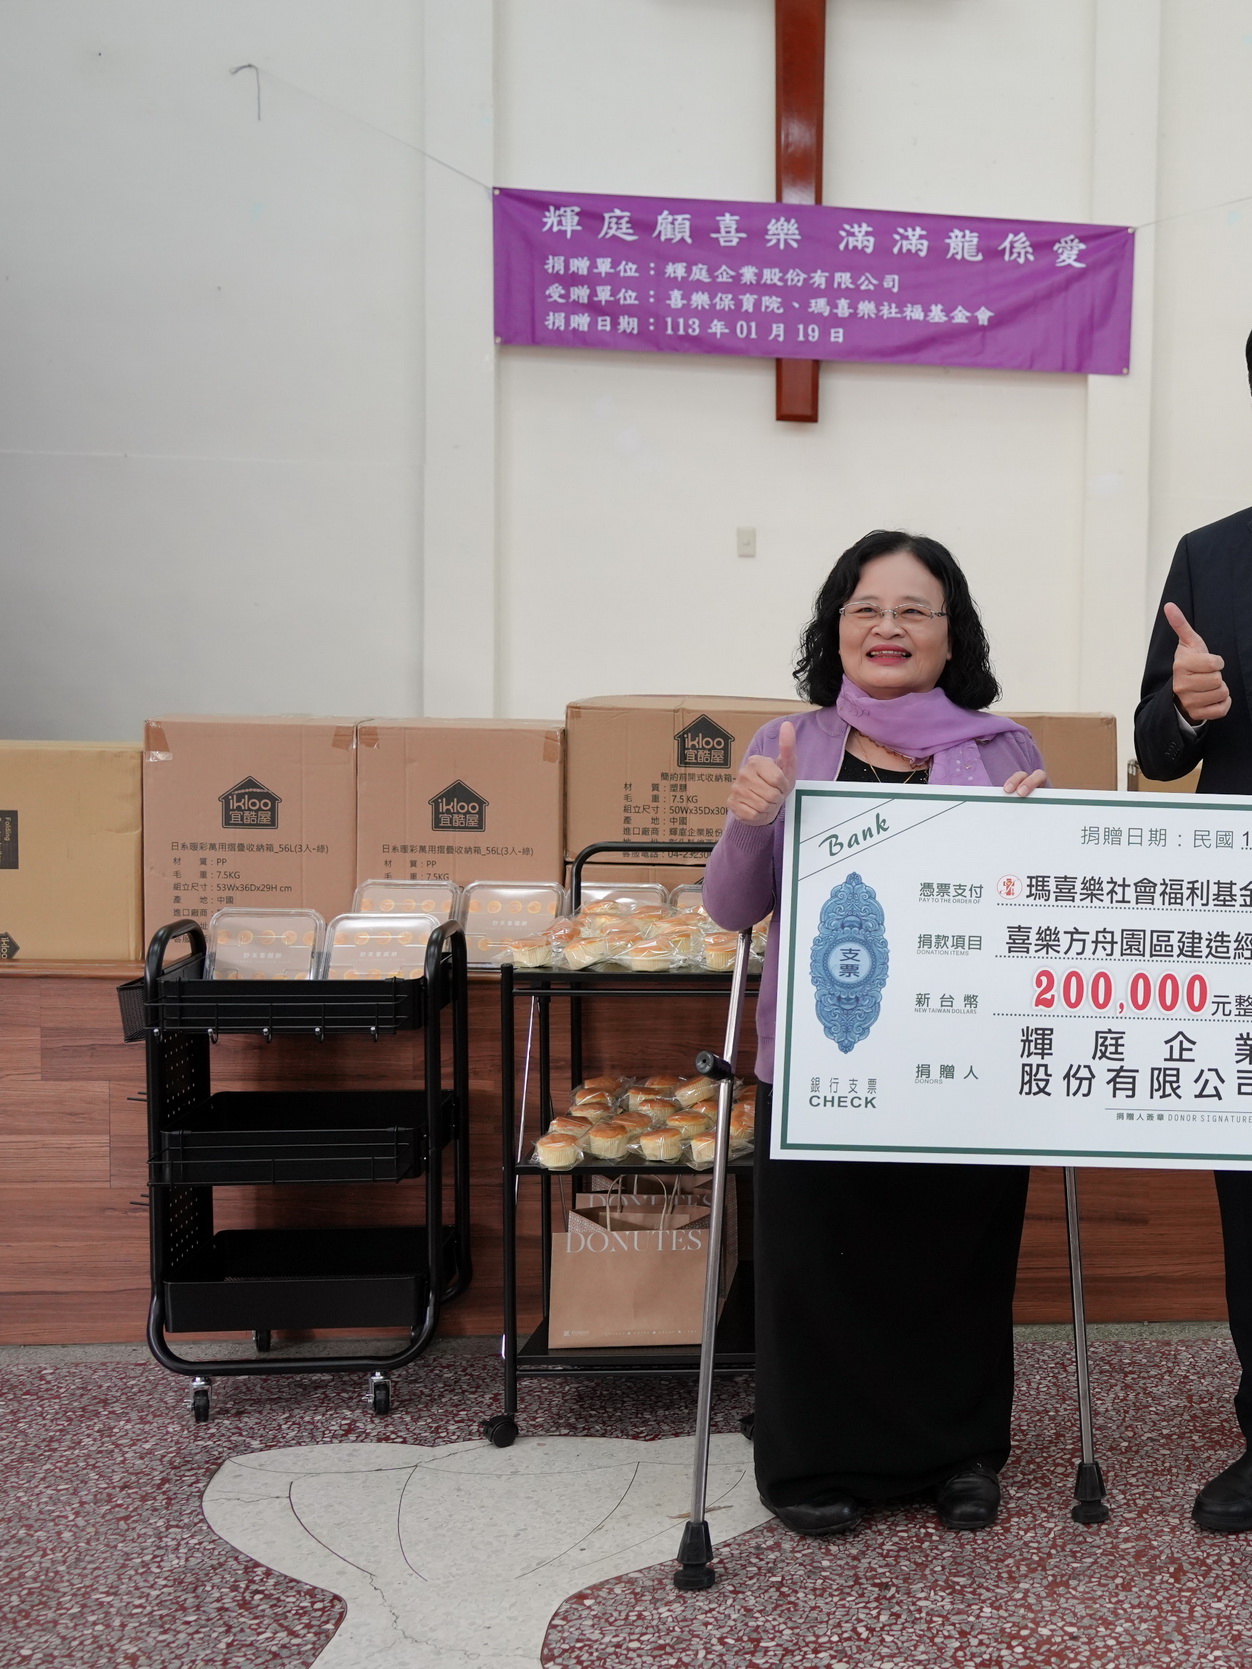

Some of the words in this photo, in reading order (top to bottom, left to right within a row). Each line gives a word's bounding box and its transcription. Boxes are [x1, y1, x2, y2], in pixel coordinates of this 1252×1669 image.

[541, 205, 802, 250] 輝庭顧喜樂
[838, 222, 1088, 268] 滿滿龍係愛
[683, 733, 725, 749] ikloo
[684, 749, 725, 763] 宜酷屋
[229, 794, 272, 810] ikloo
[438, 797, 479, 813] ikloo
[229, 811, 272, 824] 宜酷屋
[439, 813, 479, 827] 宜酷屋
[4, 816, 12, 842] Folding
[818, 812, 890, 857] Bank
[919, 882, 984, 899] 憑票支付
[917, 933, 982, 951] 捐款項目
[838, 947, 861, 978] 支票
[915, 993, 979, 1009] 新台幣
[915, 1064, 979, 1080] 捐贈人
[810, 1077, 877, 1094] 銀行支票
[809, 1095, 877, 1109] CHECK
[1168, 1113, 1197, 1122] DONOR
[1200, 1114, 1252, 1123] SIGNATURE
[566, 1229, 702, 1253] DONUTES
